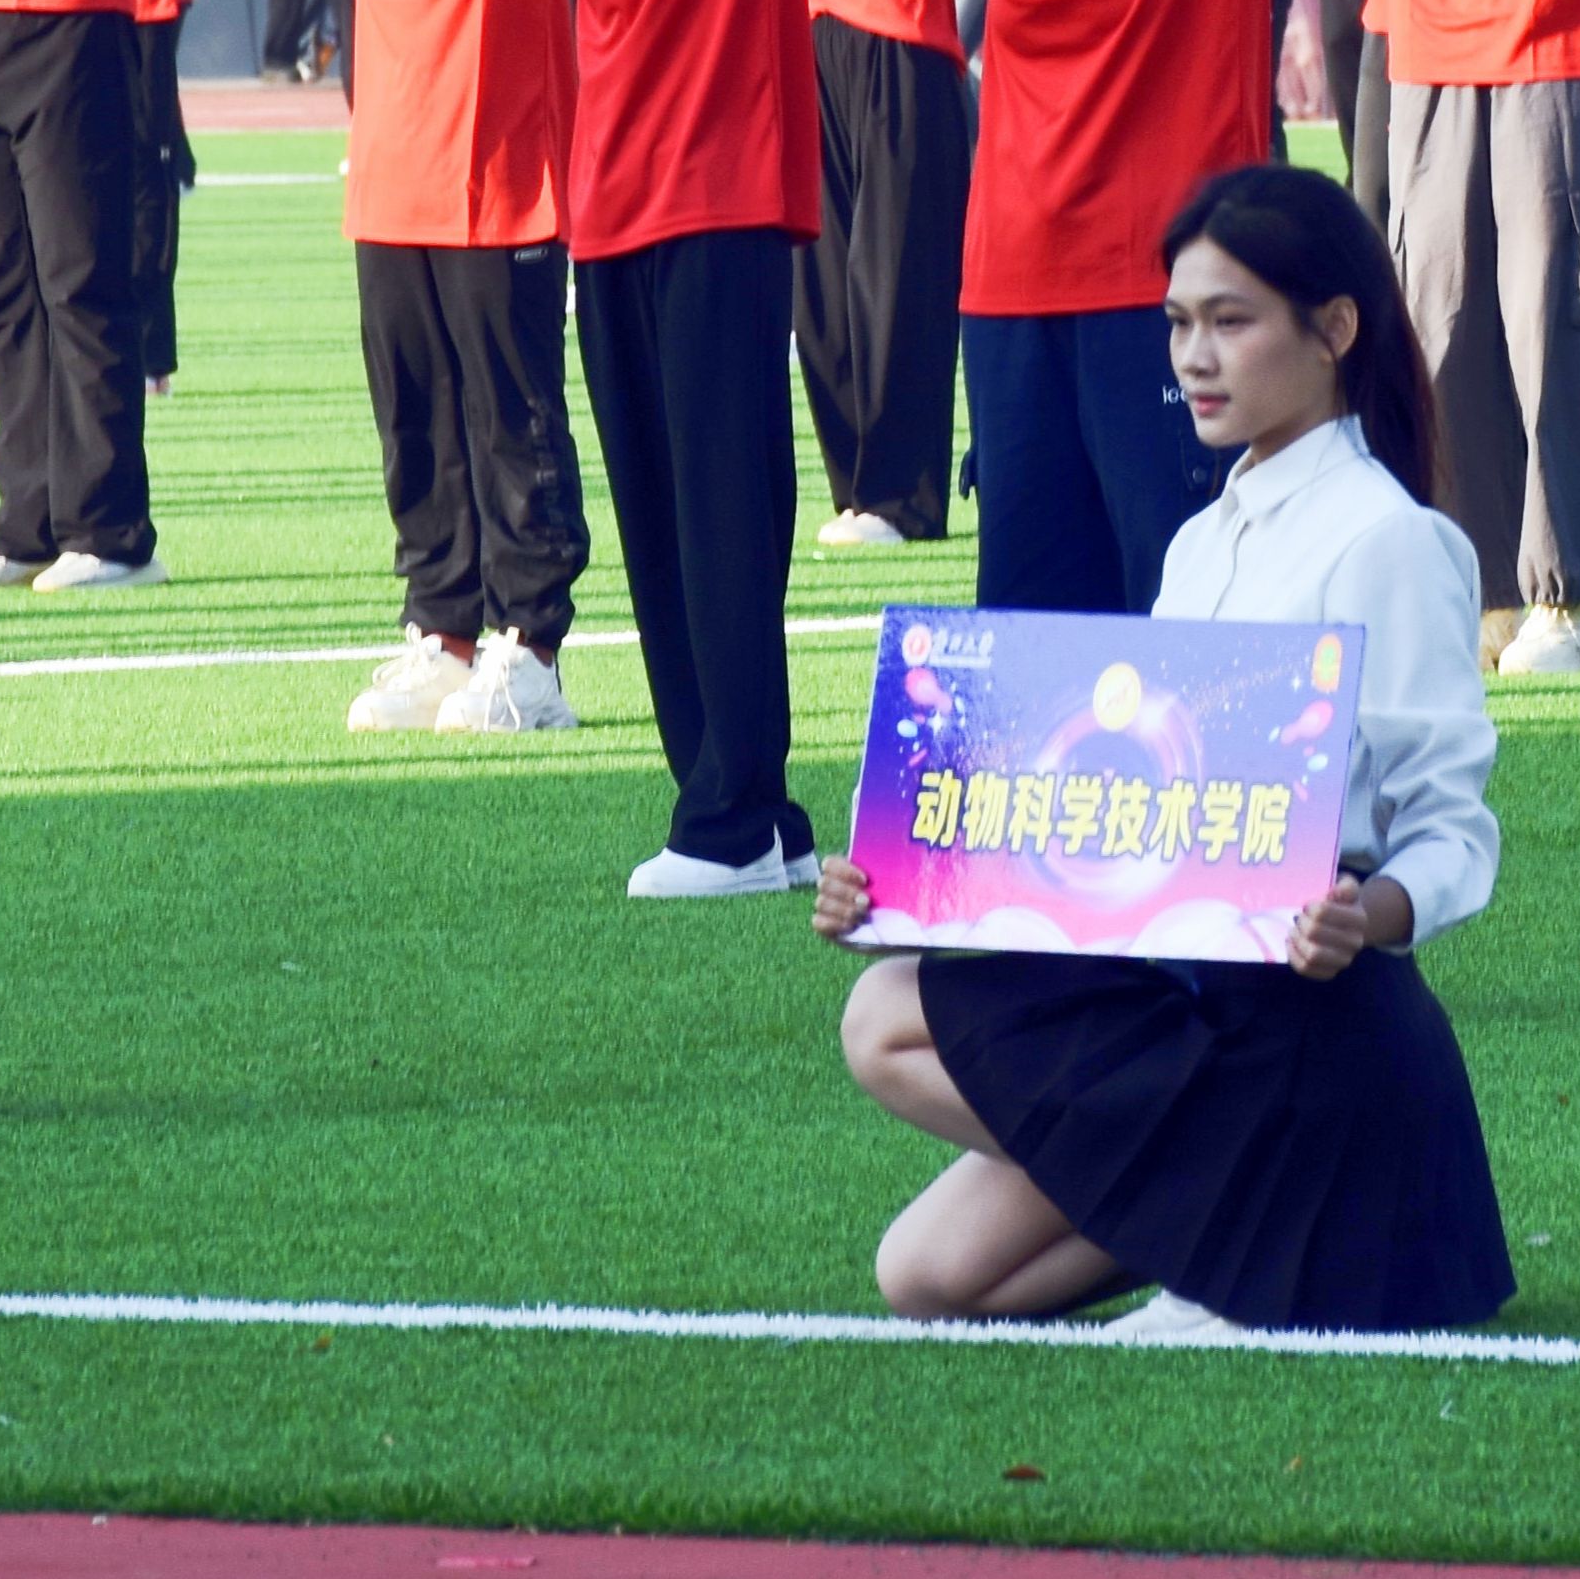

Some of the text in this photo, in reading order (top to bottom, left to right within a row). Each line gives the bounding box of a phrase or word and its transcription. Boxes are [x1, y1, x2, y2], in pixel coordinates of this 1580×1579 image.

[912, 768, 1291, 864] 动物科学技术学院
